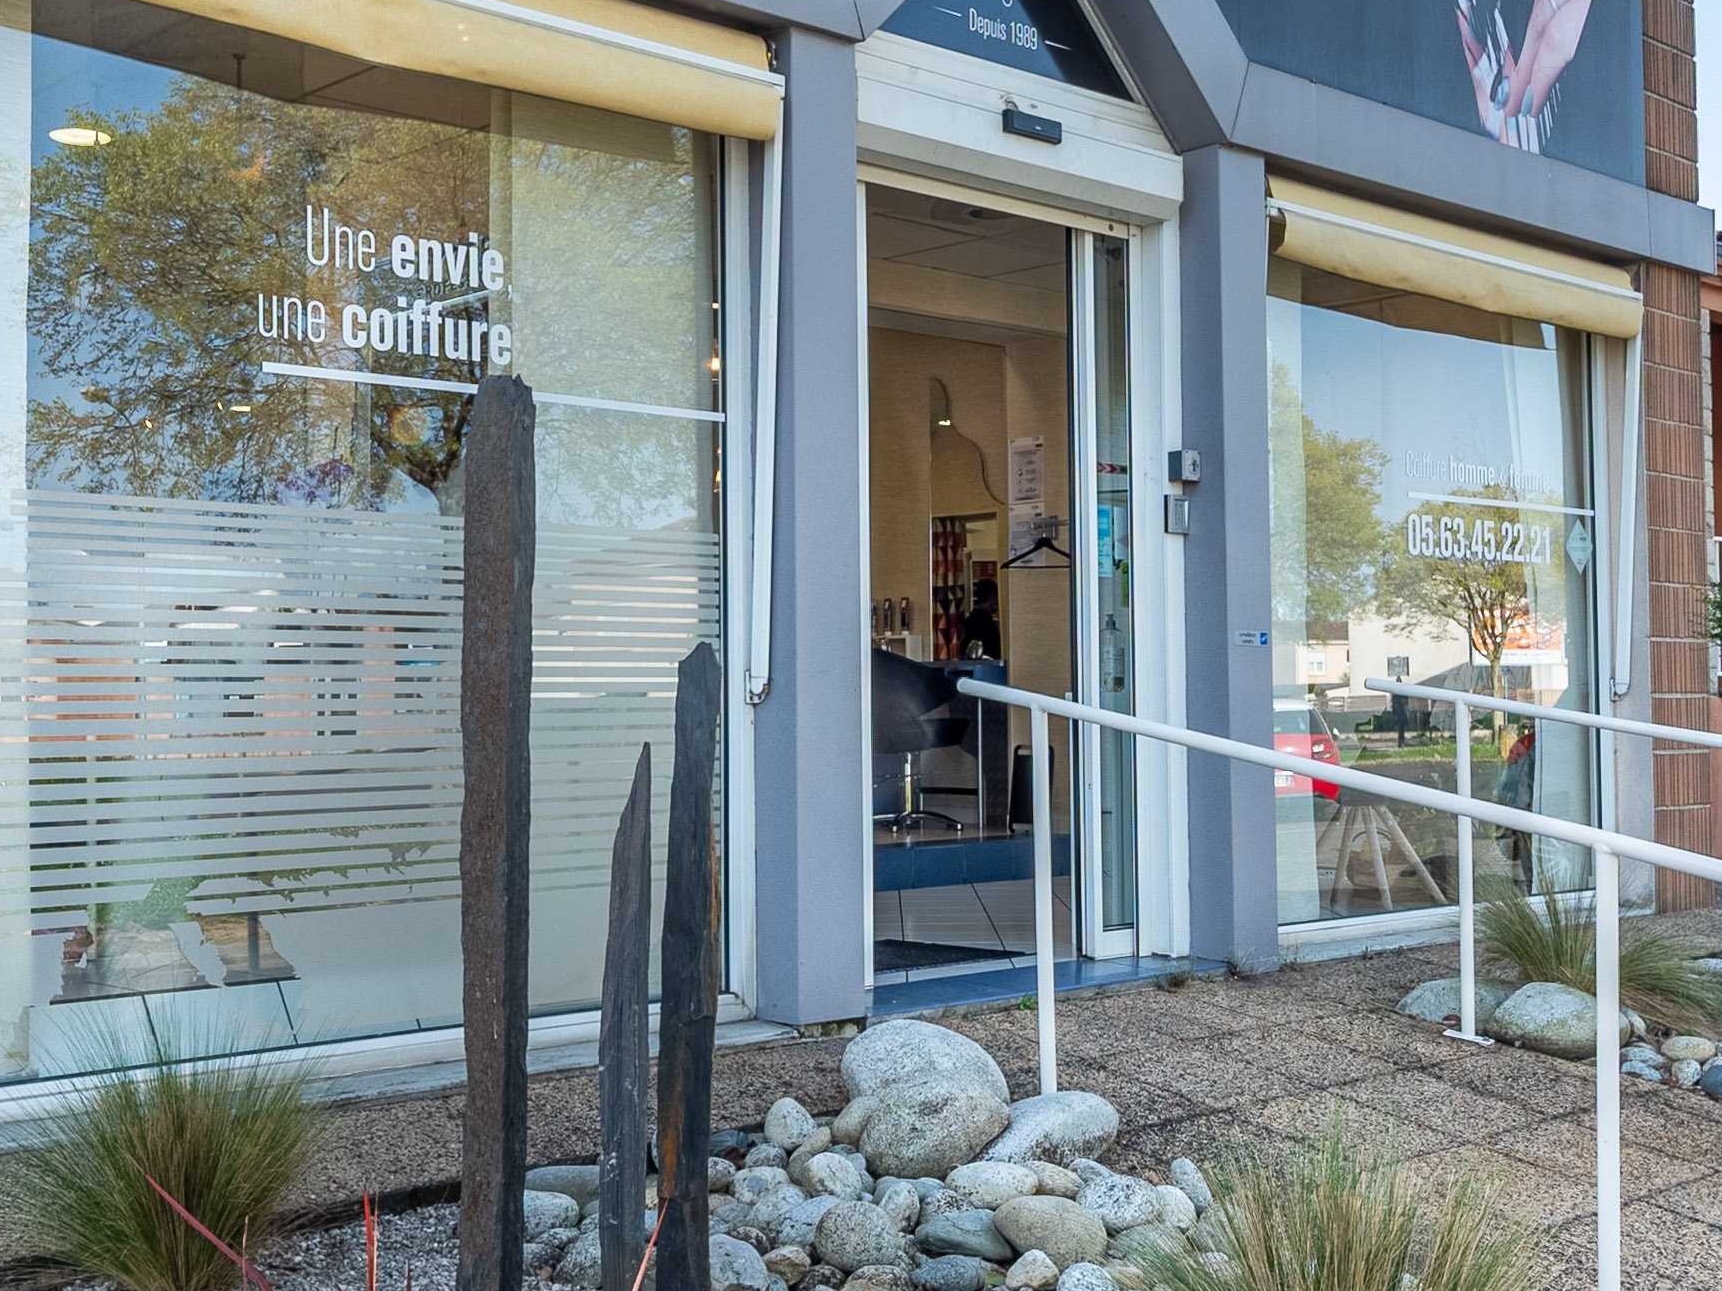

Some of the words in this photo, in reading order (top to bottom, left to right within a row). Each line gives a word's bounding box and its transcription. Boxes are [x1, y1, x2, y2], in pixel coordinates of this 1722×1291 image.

[967, 7, 1007, 42] Depuis
[1009, 20, 1039, 51] 1989
[305, 204, 377, 273] Une
[257, 292, 327, 344] une
[341, 295, 513, 367] coiffure
[1405, 449, 1447, 481] Coiffure
[1448, 454, 1495, 486] homme
[1497, 466, 1508, 488] &
[1509, 463, 1550, 492] femme
[1406, 513, 1552, 565] 05.63.45.22.21
